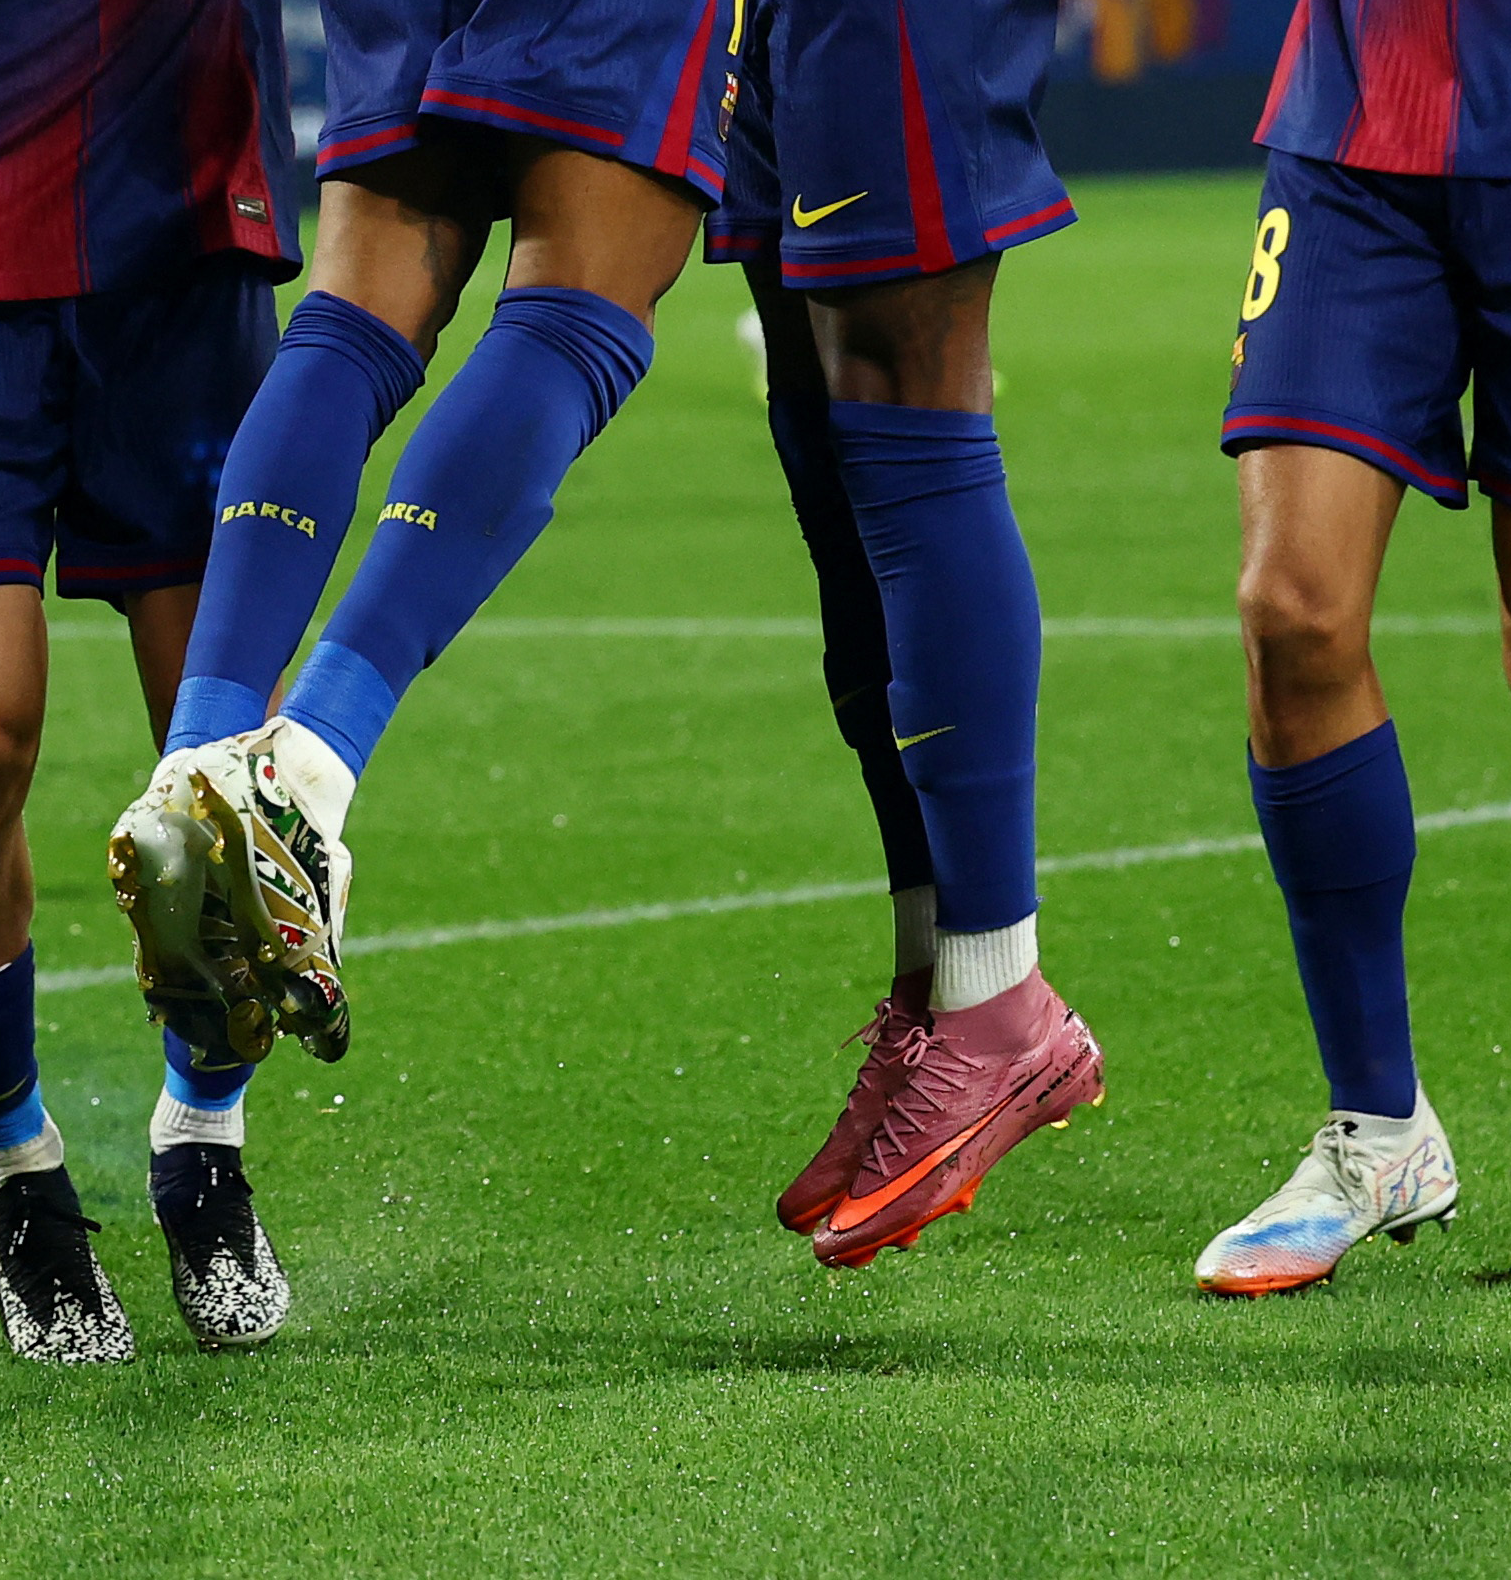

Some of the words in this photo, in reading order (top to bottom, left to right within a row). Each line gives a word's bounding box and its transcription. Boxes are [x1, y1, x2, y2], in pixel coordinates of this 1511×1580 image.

[1241, 207, 1291, 322] 8
[220, 500, 317, 540] BARÇA
[377, 502, 438, 531] ARÇA
